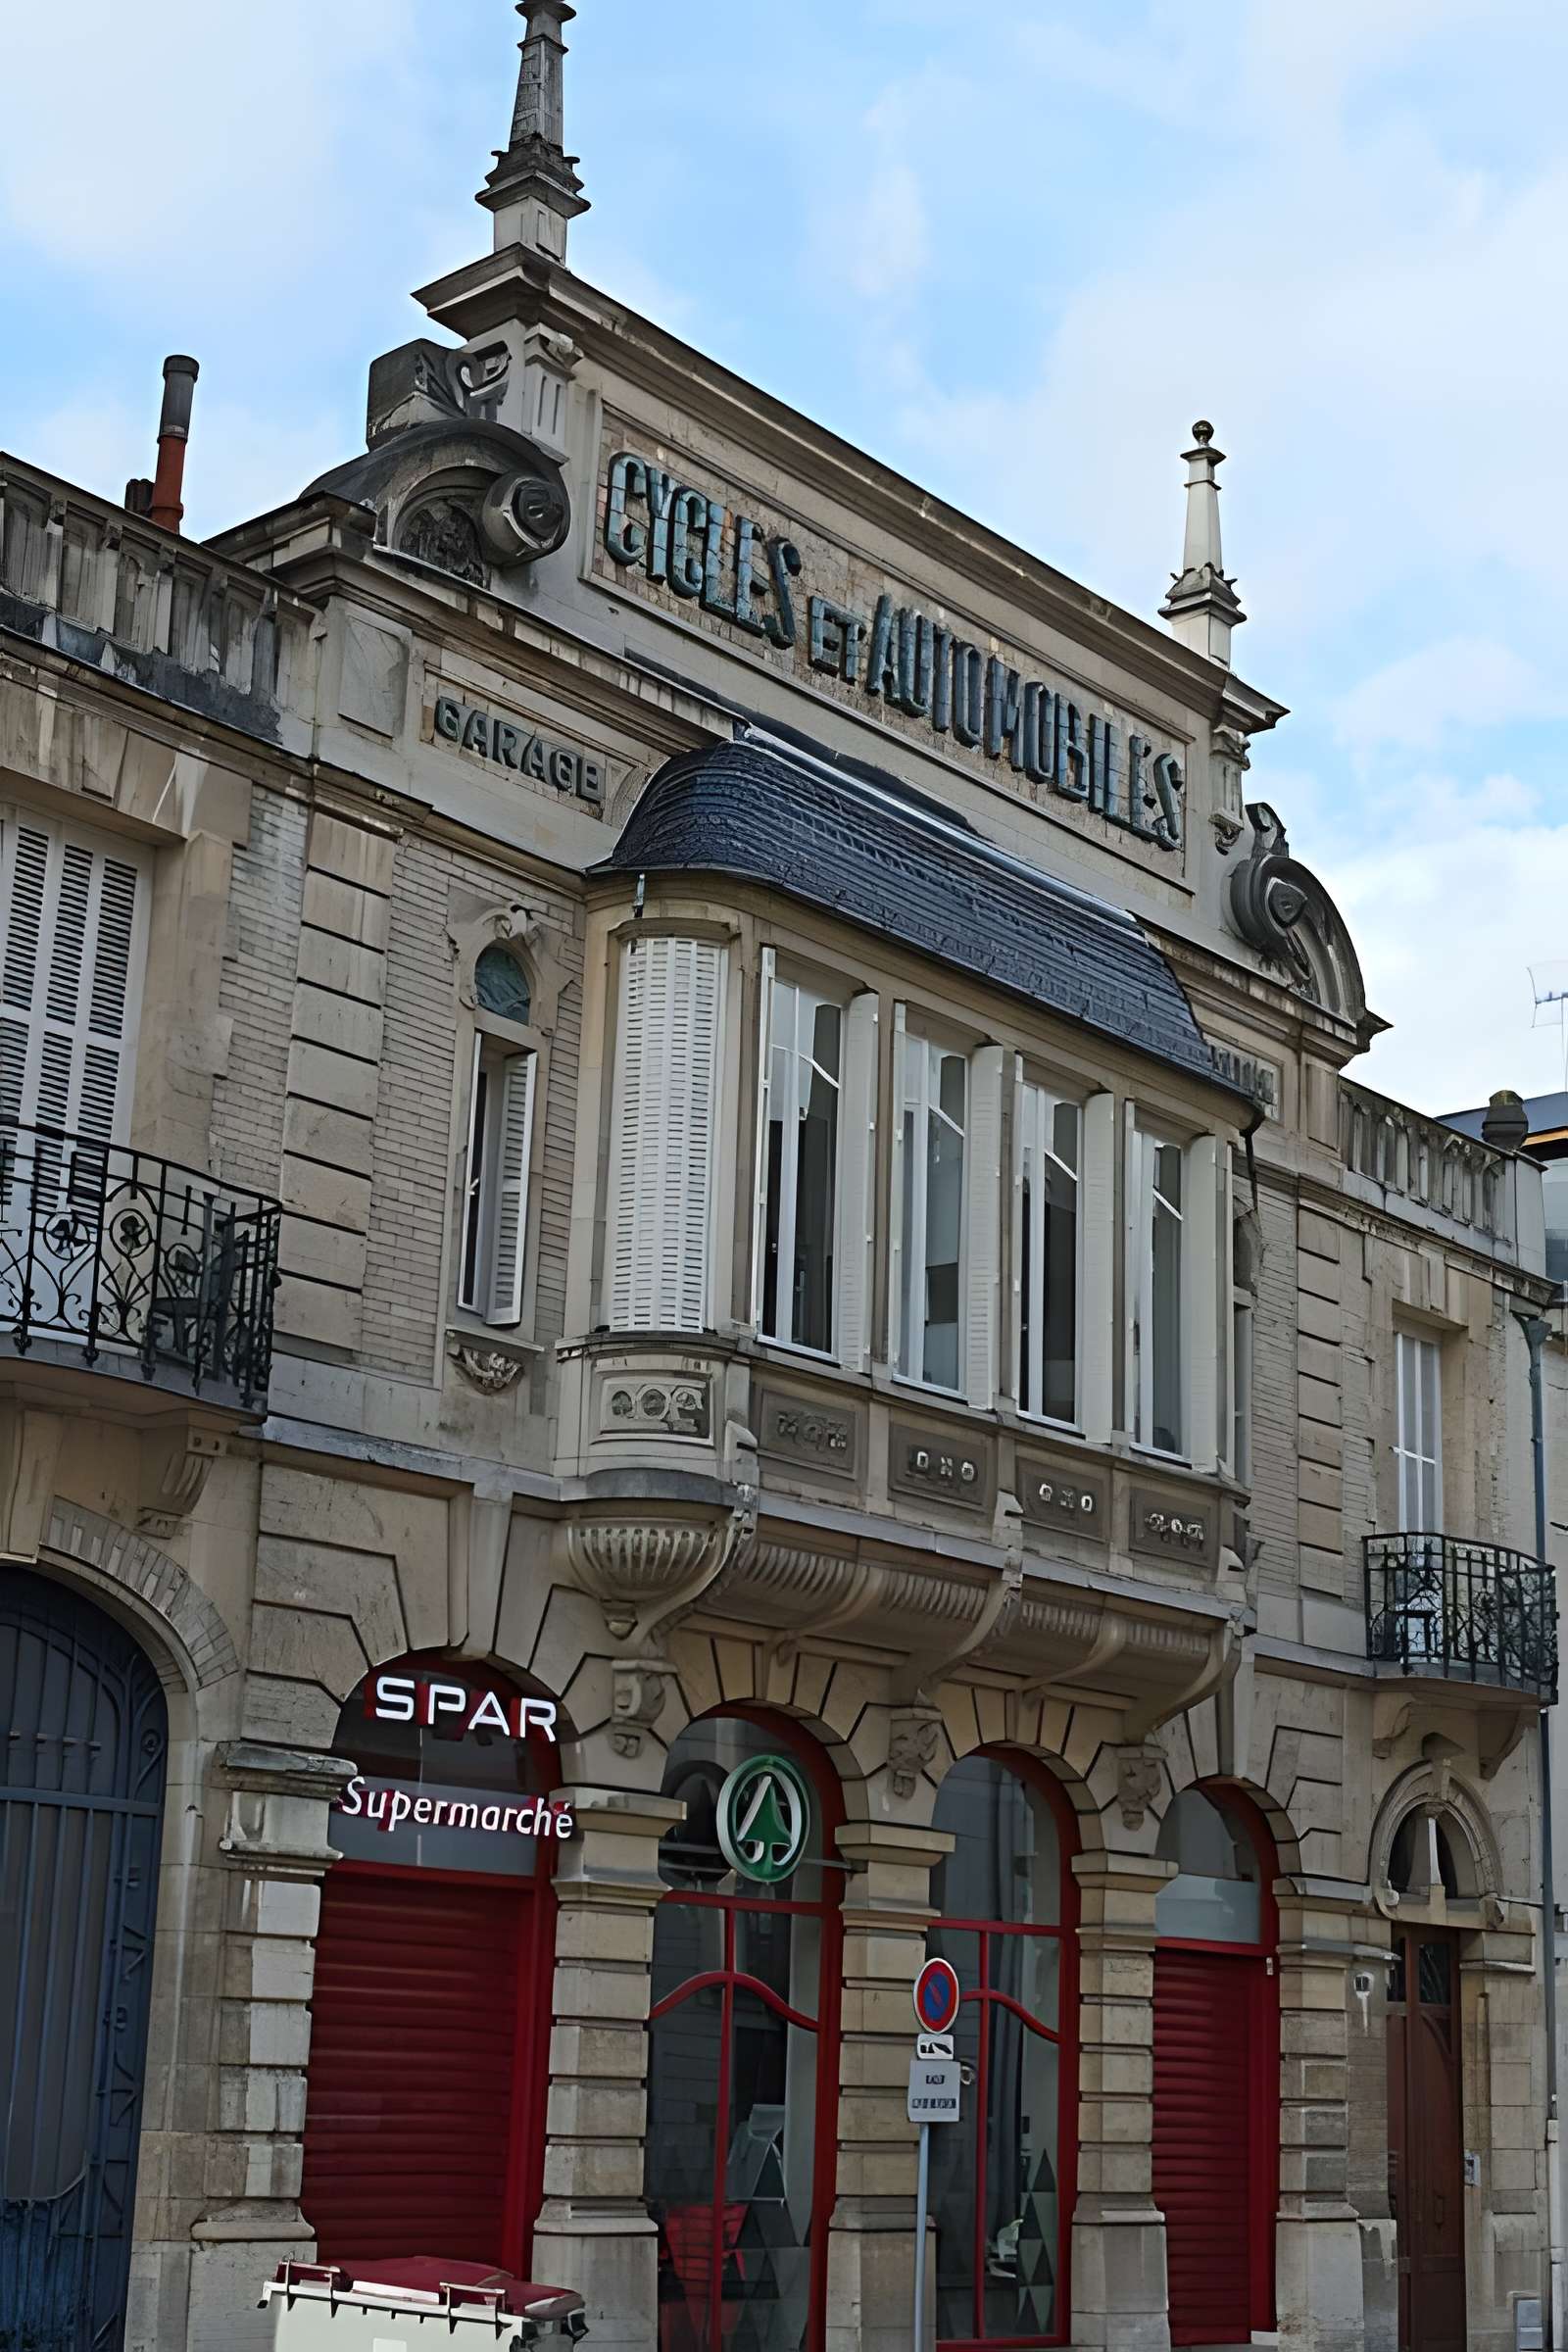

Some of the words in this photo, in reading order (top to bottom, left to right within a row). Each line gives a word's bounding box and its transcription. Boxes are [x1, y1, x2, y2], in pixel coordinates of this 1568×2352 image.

[604, 451, 803, 650] CYCLES
[808, 595, 866, 685] ET
[864, 594, 1185, 852] AUTOMOBILES
[435, 696, 607, 802] GARAGE
[373, 1676, 557, 1742] SPAR
[341, 1776, 574, 1838] Supermarché
